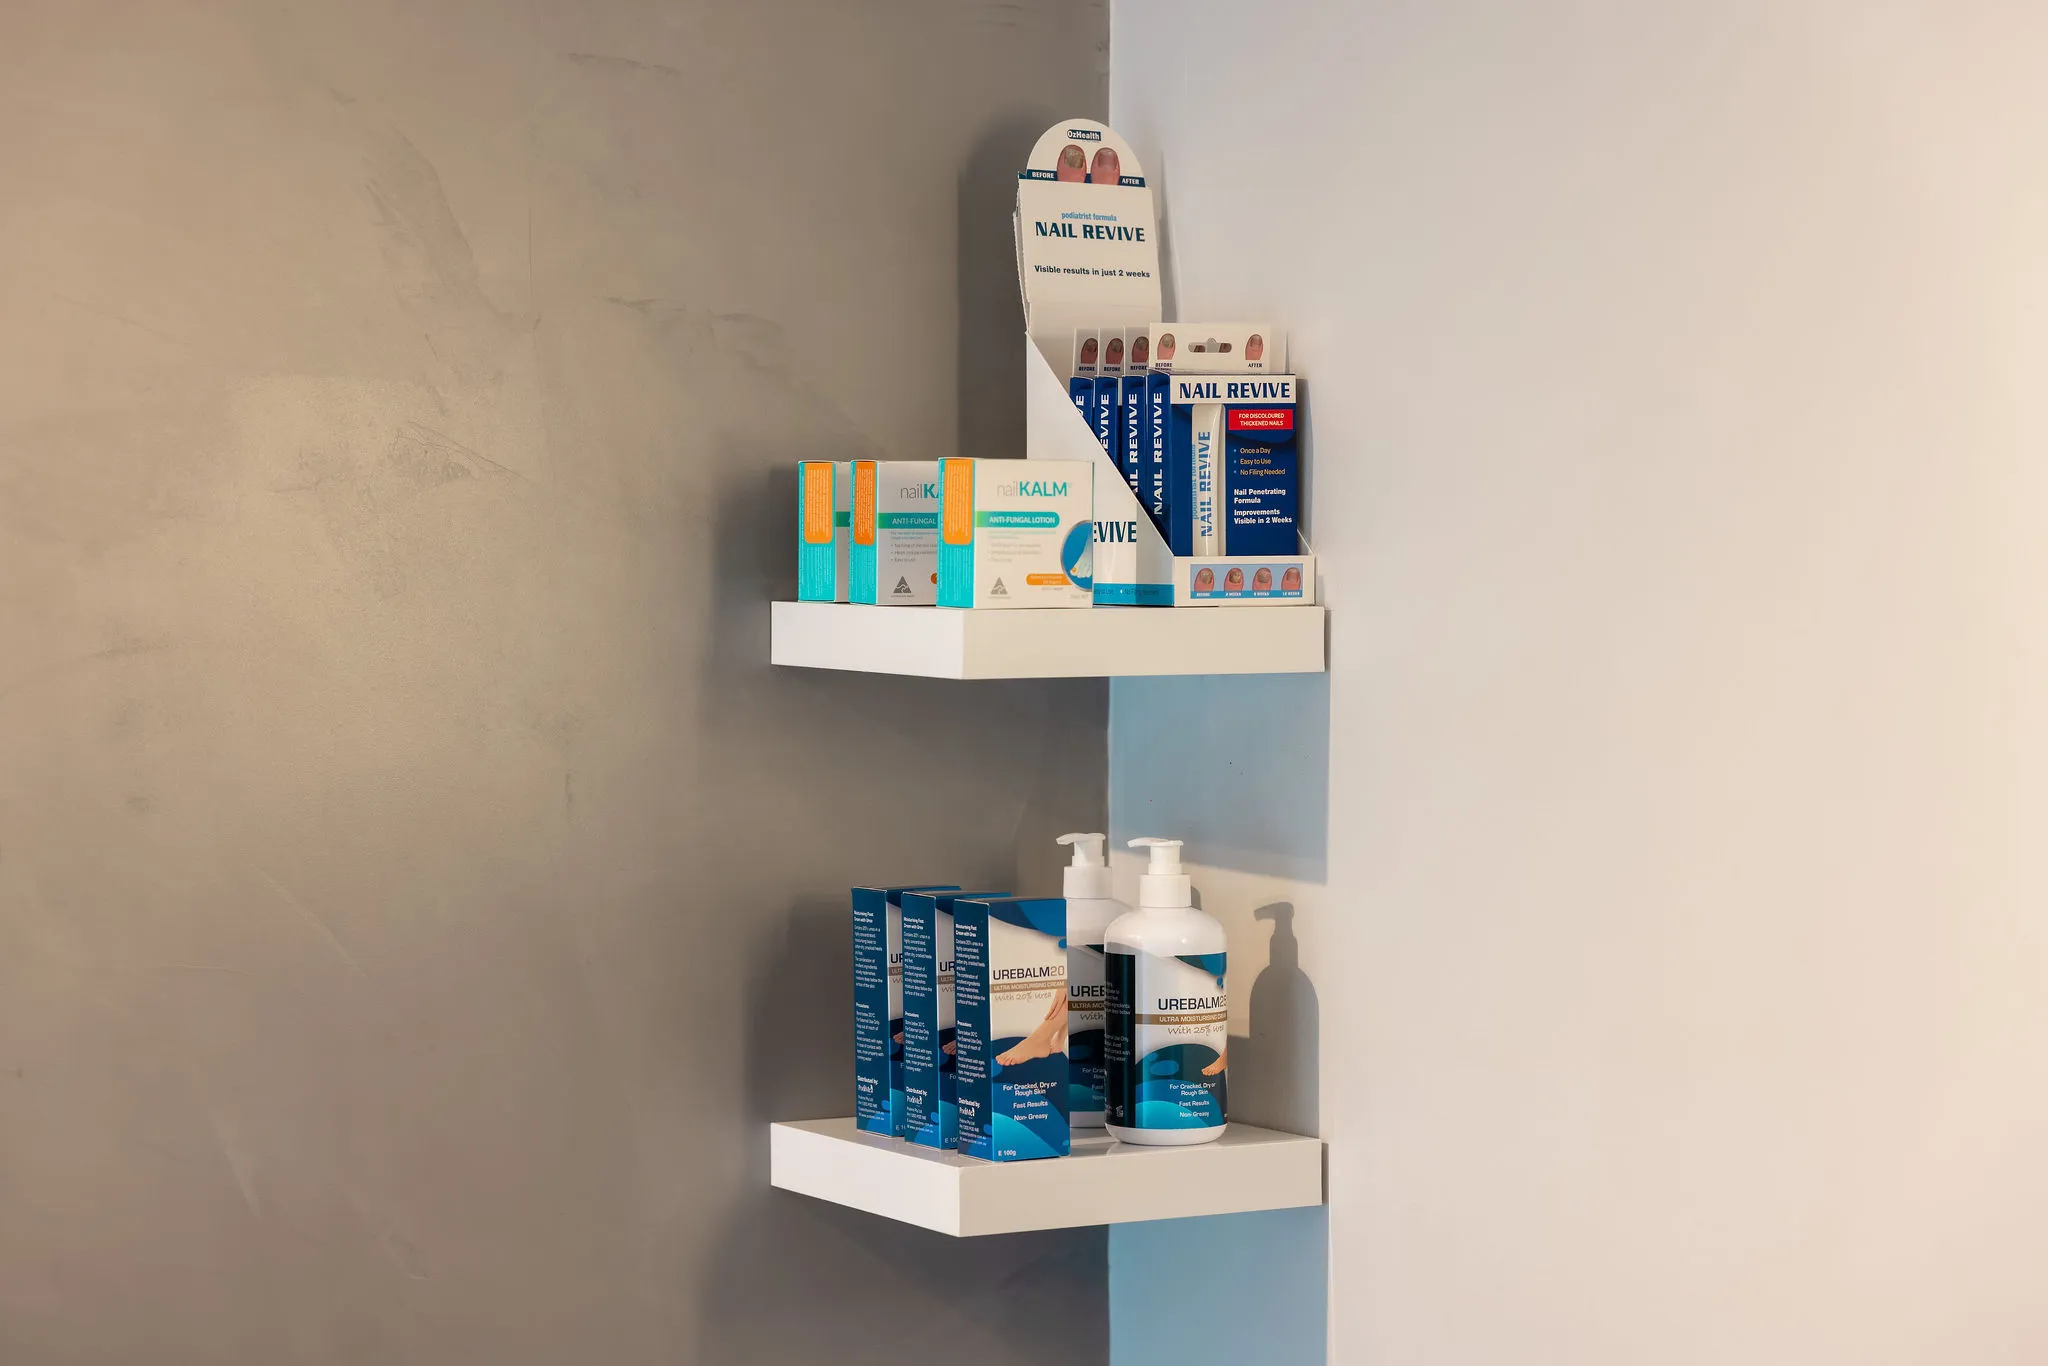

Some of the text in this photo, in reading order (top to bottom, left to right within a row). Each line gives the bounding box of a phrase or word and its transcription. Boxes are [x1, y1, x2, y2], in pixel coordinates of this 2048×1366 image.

[1067, 130, 1100, 140] OzHealth
[1061, 212, 1092, 220] podiatrist
[1035, 221, 1146, 242] NAIL REVIVE
[1034, 264, 1061, 274] Visible
[1063, 267, 1090, 276] results
[1102, 268, 1116, 278] just
[1126, 270, 1151, 278] weeks
[1180, 382, 1290, 398] NAIL REVIVE
[1128, 394, 1138, 464] REVIVE
[1154, 392, 1162, 515] NAIL REVIVE
[900, 484, 938, 499] nailK
[997, 480, 1068, 497] nailKALM
[1198, 432, 1212, 536] NAIL REVIVE
[1248, 488, 1286, 496] Penetrating
[993, 965, 1064, 980] UREBALM20
[1168, 1025, 1191, 1034] With
[1193, 1025, 1210, 1036] 25%
